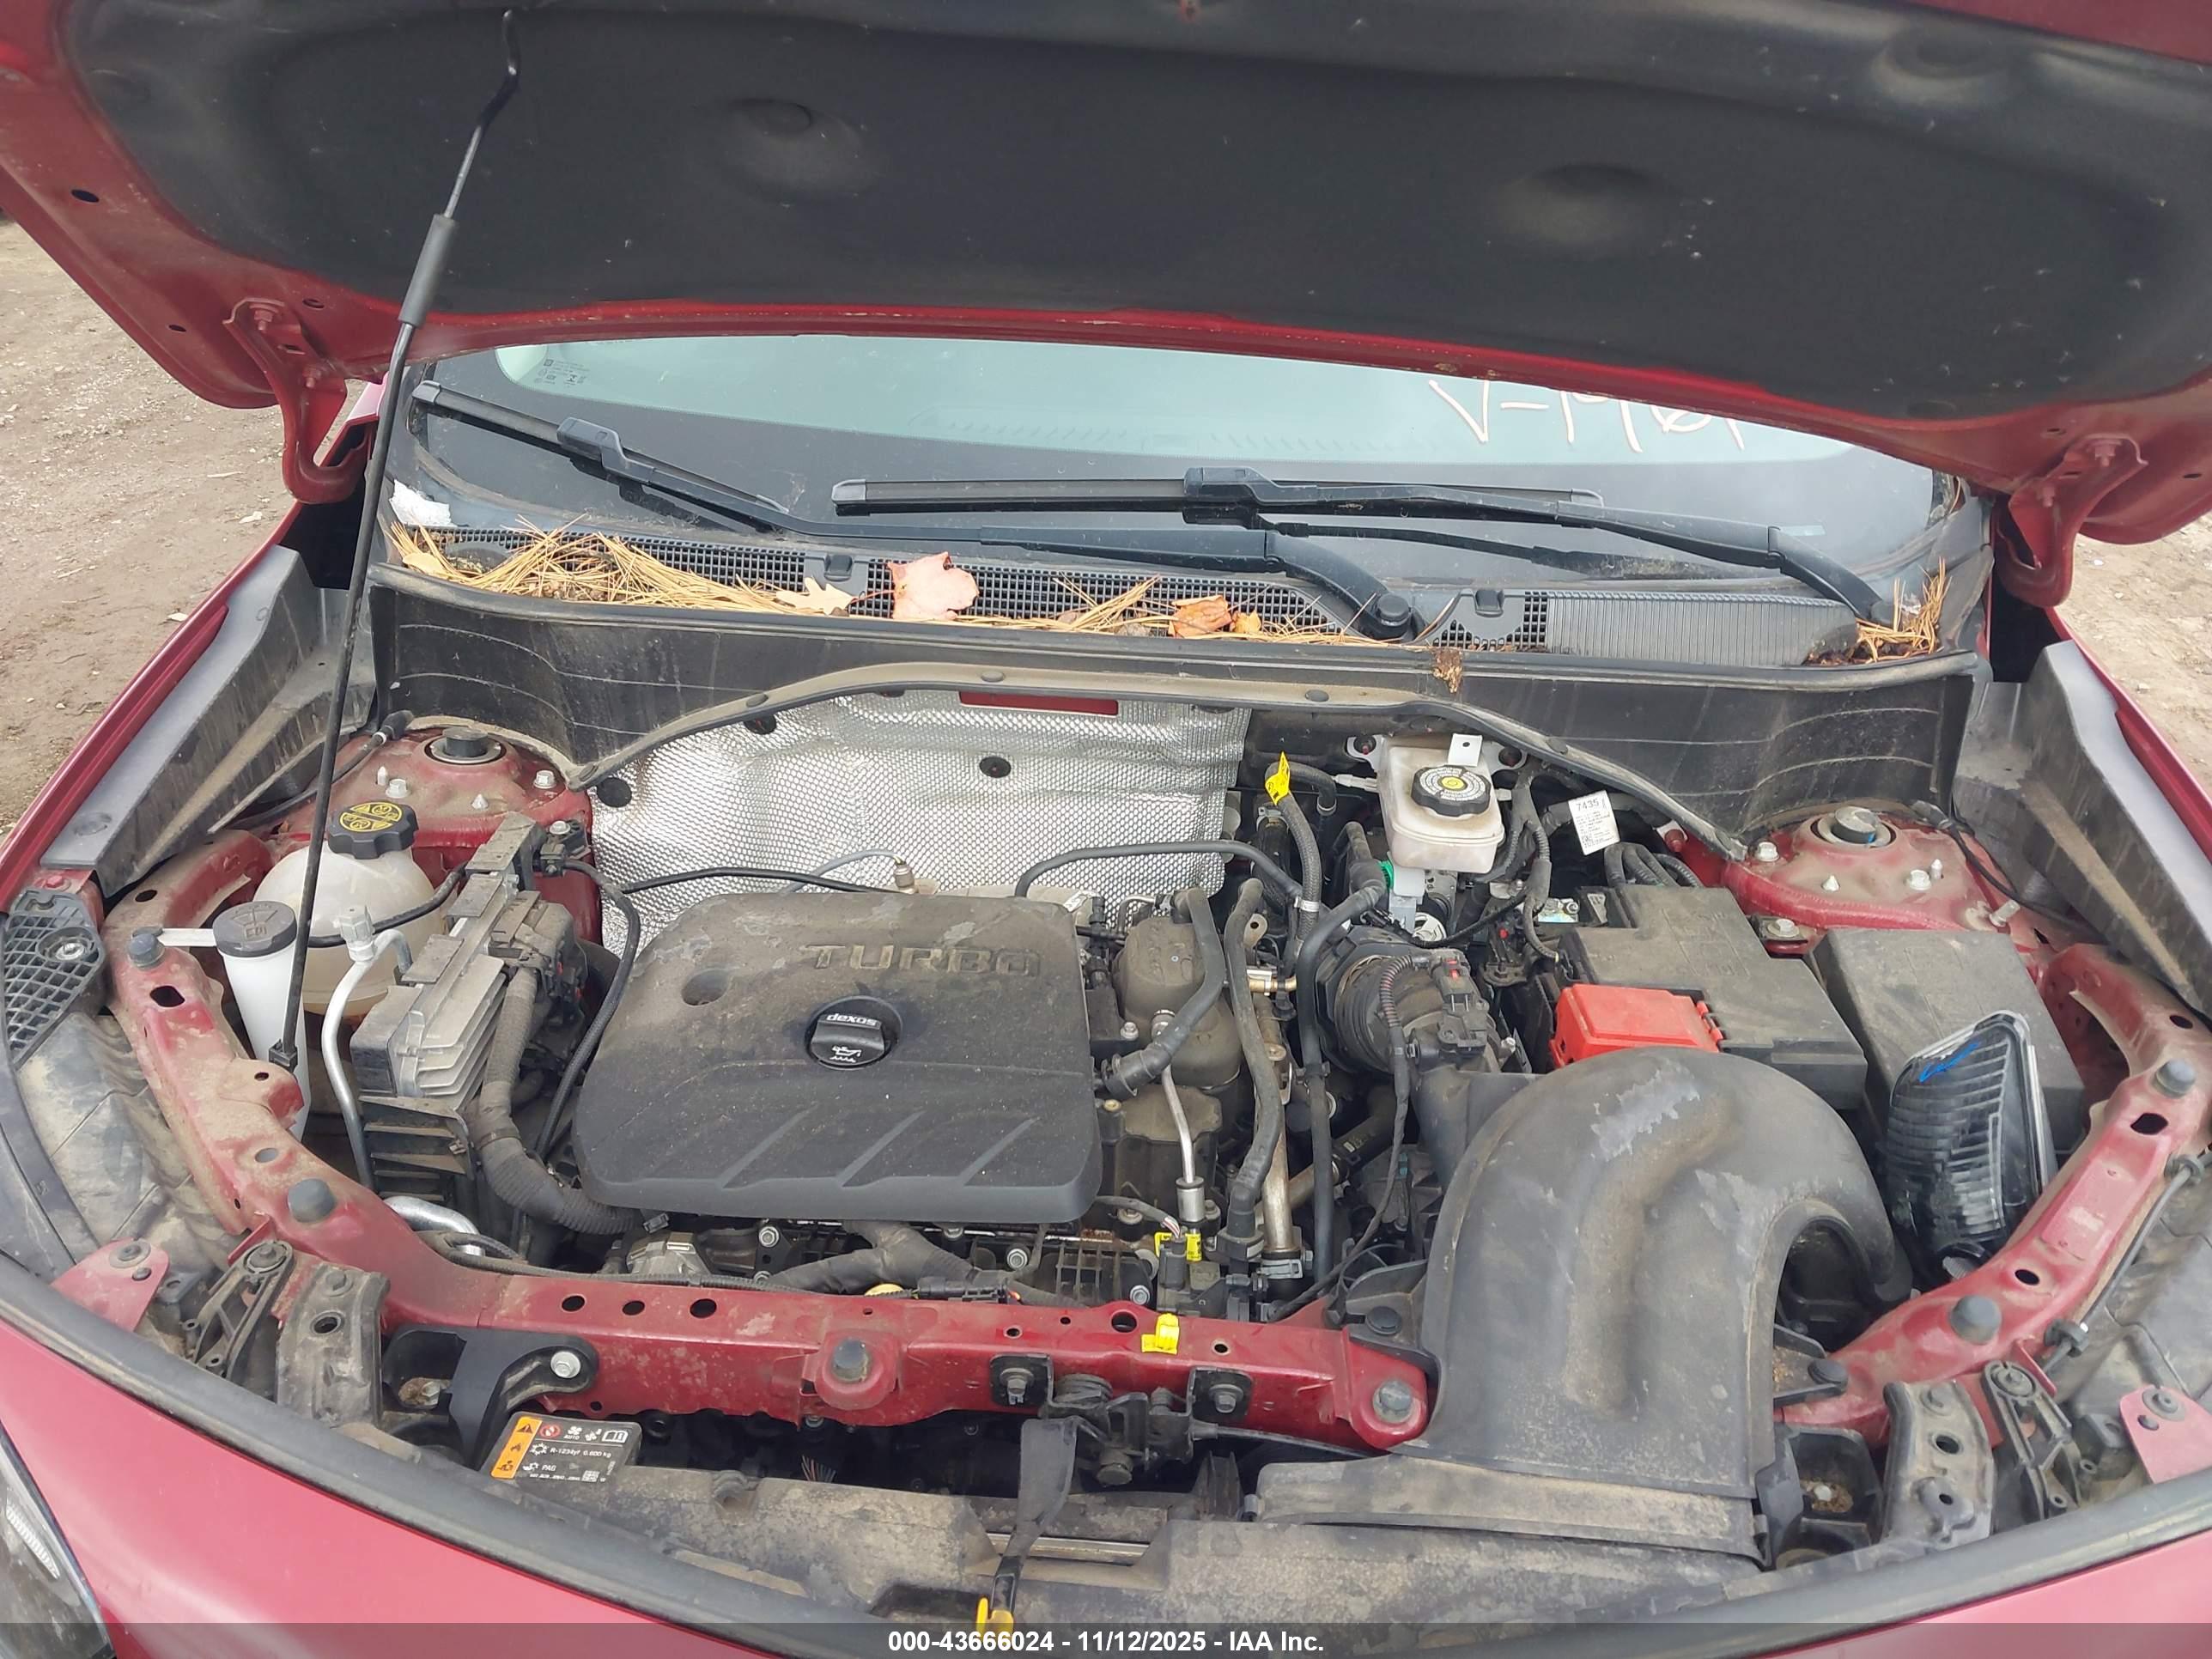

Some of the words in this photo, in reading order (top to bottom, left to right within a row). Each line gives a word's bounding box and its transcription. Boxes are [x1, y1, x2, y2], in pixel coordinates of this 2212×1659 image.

[1576, 798, 1600, 811] 7435
[799, 944, 1041, 976] TURBO
[826, 1013, 877, 1026] dexos
